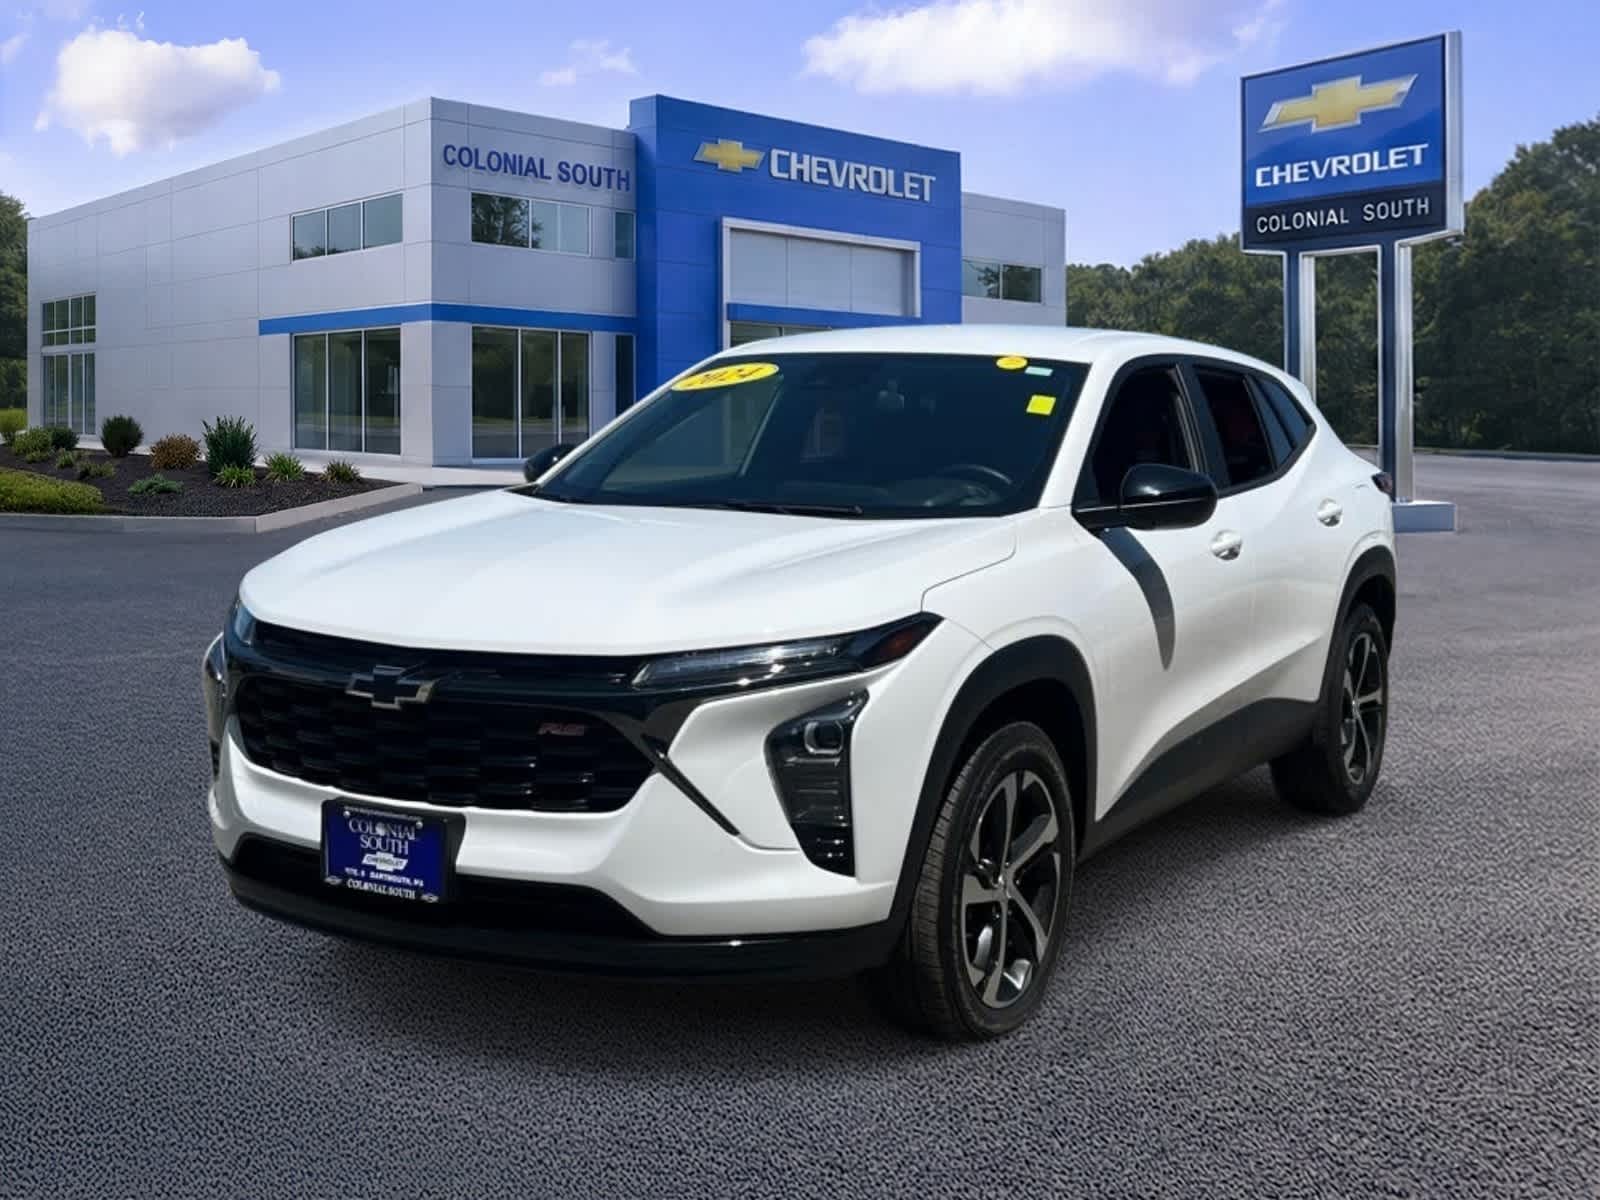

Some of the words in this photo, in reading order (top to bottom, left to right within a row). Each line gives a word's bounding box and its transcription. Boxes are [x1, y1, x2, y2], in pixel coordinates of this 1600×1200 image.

[443, 143, 552, 181] COLONIAL
[557, 161, 631, 193] SOUTH
[769, 148, 937, 203] CHEVROLET
[1255, 143, 1429, 187] CHEVROLET
[1256, 208, 1349, 233] COLONIAL
[1362, 198, 1430, 222] SOUTH
[348, 818, 415, 840] COLONIAL
[360, 834, 409, 855] SOUTH
[388, 888, 416, 900] SOUTH
